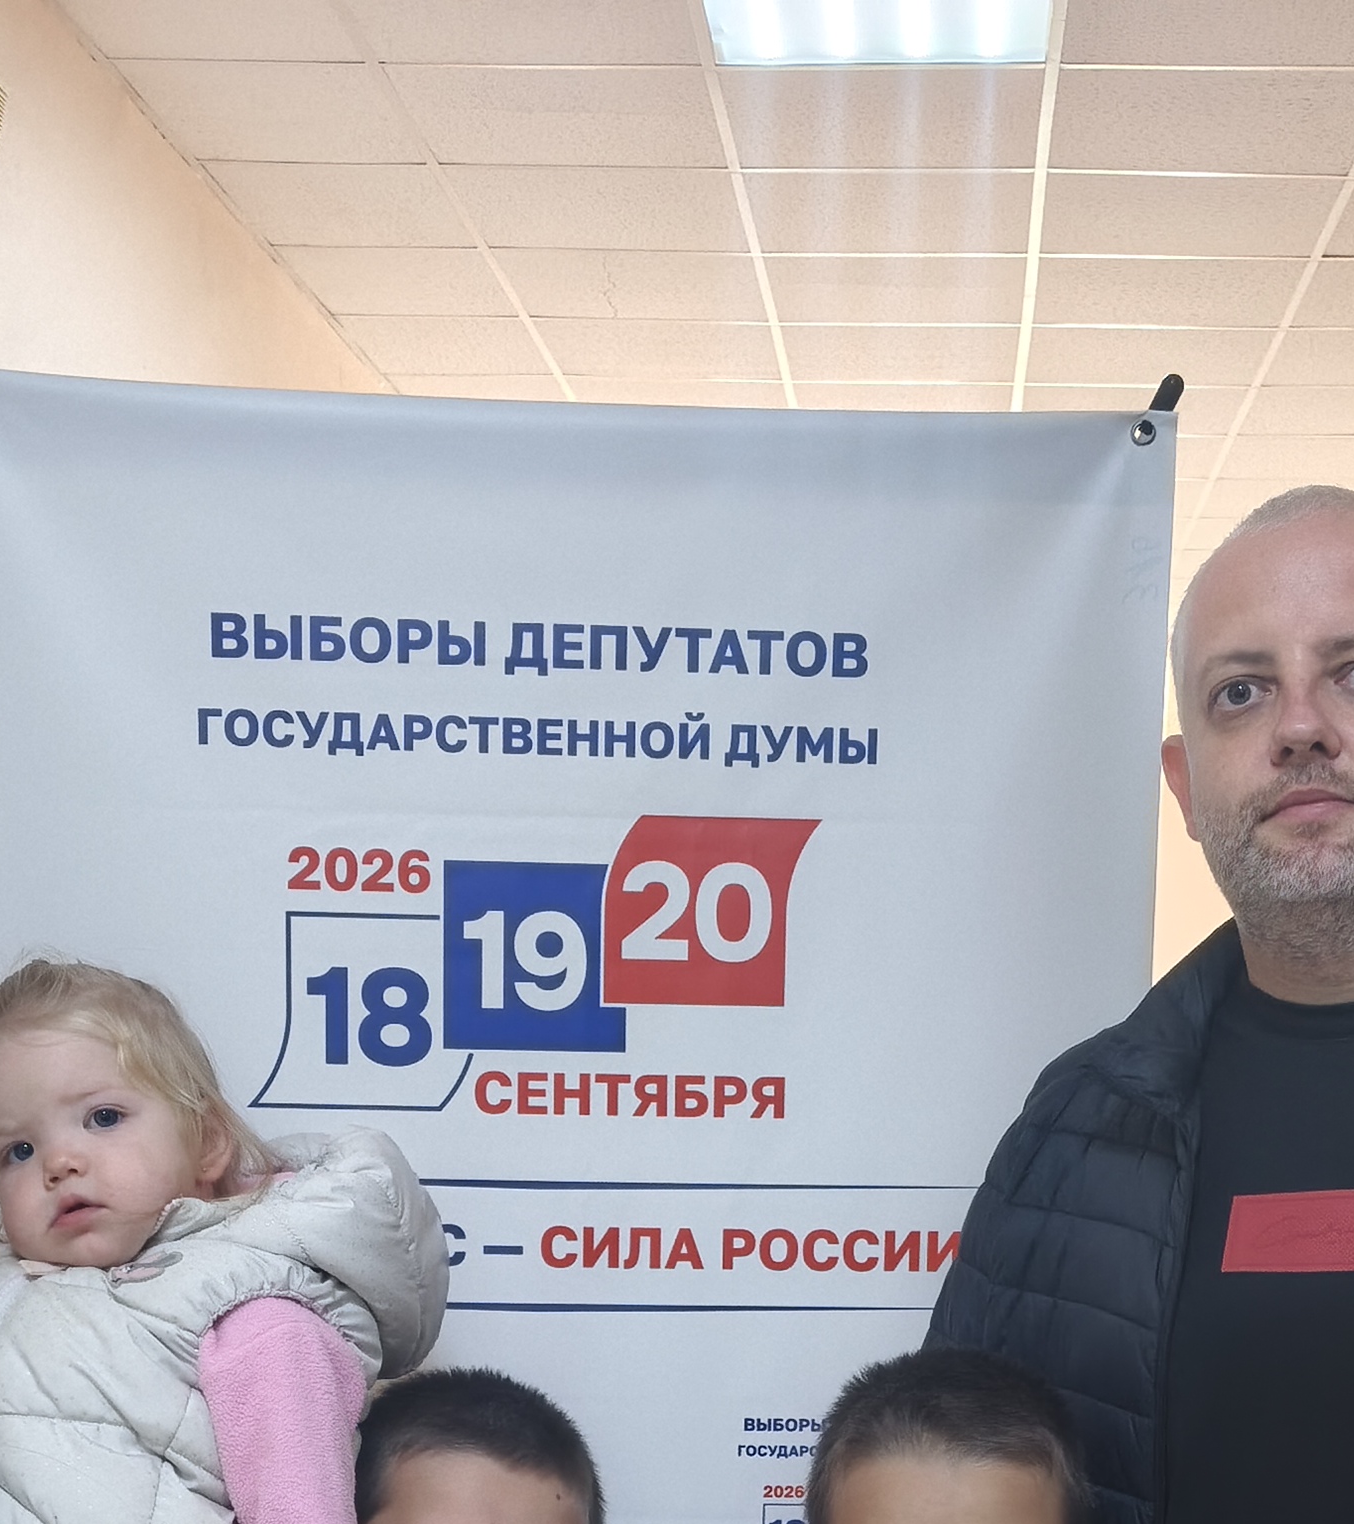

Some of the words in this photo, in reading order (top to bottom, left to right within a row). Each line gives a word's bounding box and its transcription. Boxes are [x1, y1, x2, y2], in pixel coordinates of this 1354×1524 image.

[210, 612, 486, 666] ВЫБОРЫ
[504, 622, 870, 678] ДЕПУТАТОВ
[197, 707, 712, 760] ГОСУДАРСТВЕННОЙ
[724, 724, 878, 768] ДУМЫ
[287, 846, 432, 894] 2026
[305, 966, 433, 1068] 18
[462, 909, 588, 1012] 19
[619, 860, 773, 963] 20
[473, 1070, 786, 1120] СЕНТЯБРЯ
[540, 1225, 705, 1271] СИЛА
[763, 1484, 806, 1499] 2026
